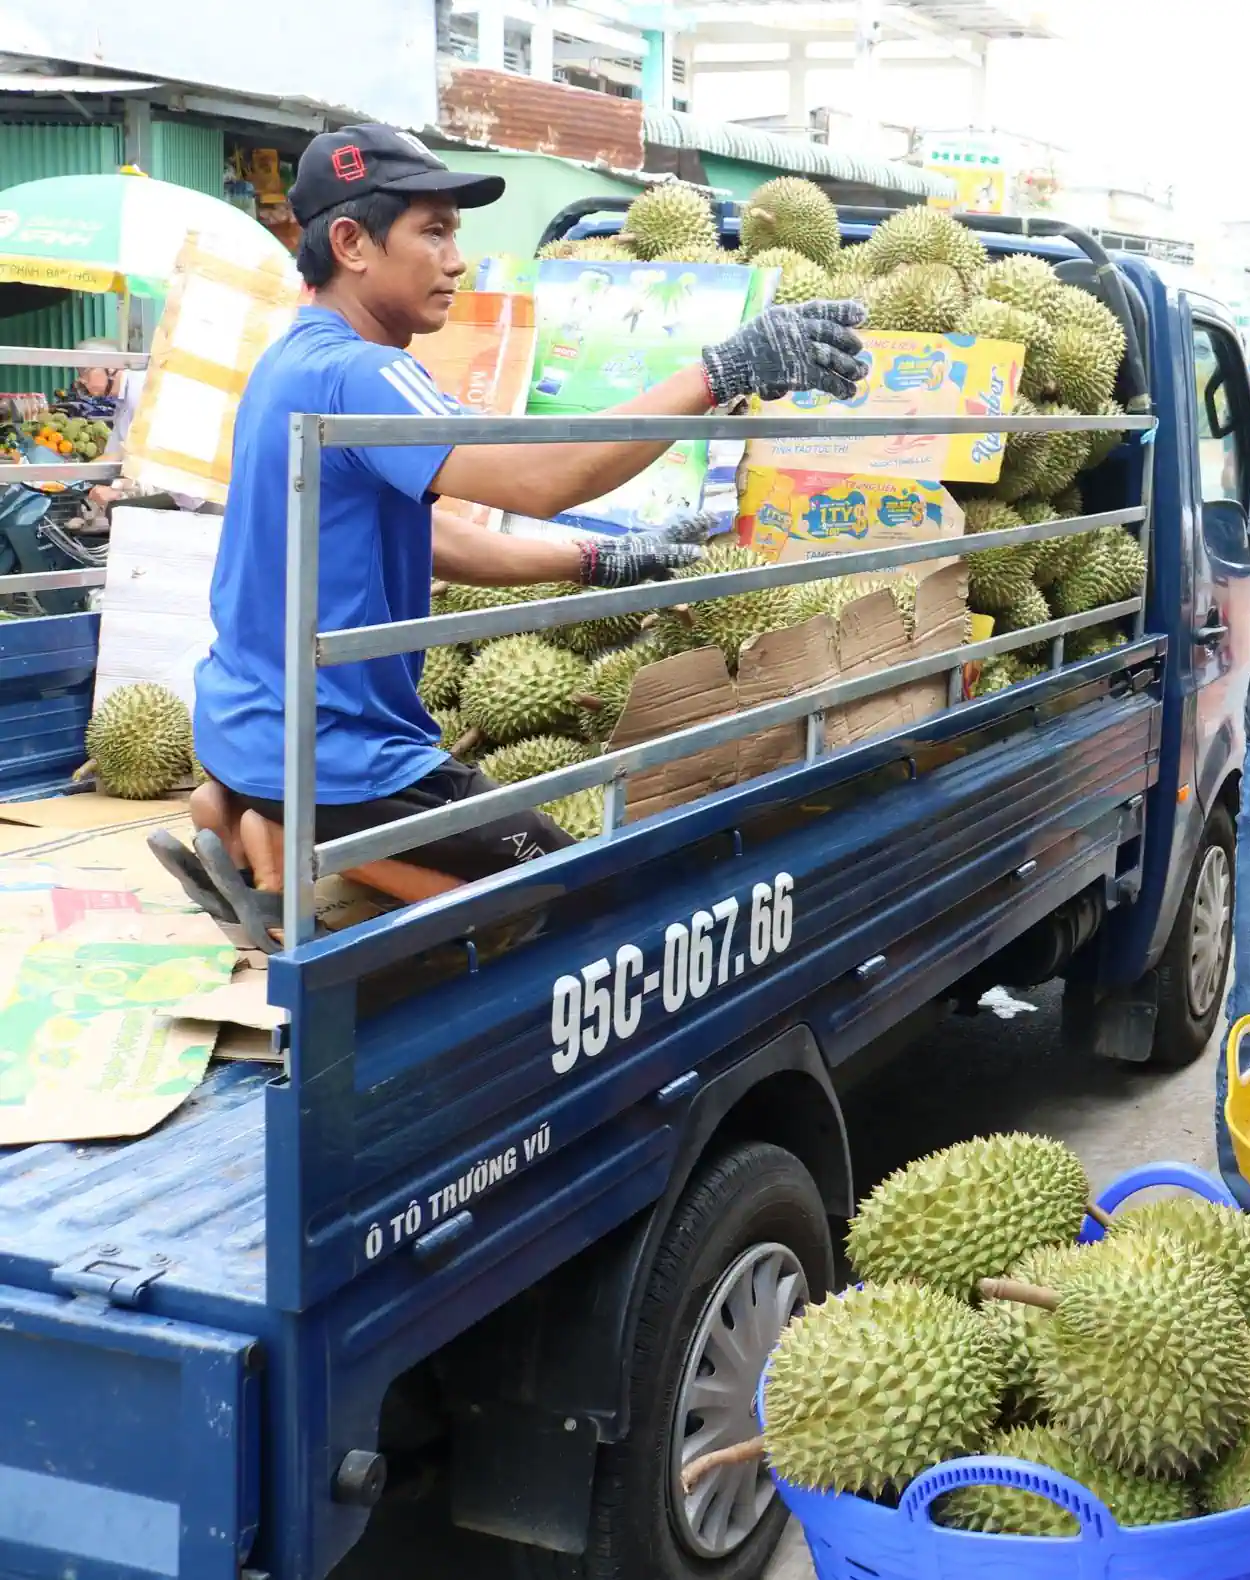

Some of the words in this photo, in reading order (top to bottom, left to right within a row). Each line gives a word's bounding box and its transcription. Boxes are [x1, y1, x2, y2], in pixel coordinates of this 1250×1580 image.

[365, 1222, 383, 1260] Ô
[390, 1199, 422, 1244] TÔ
[523, 1121, 551, 1163] VŨ
